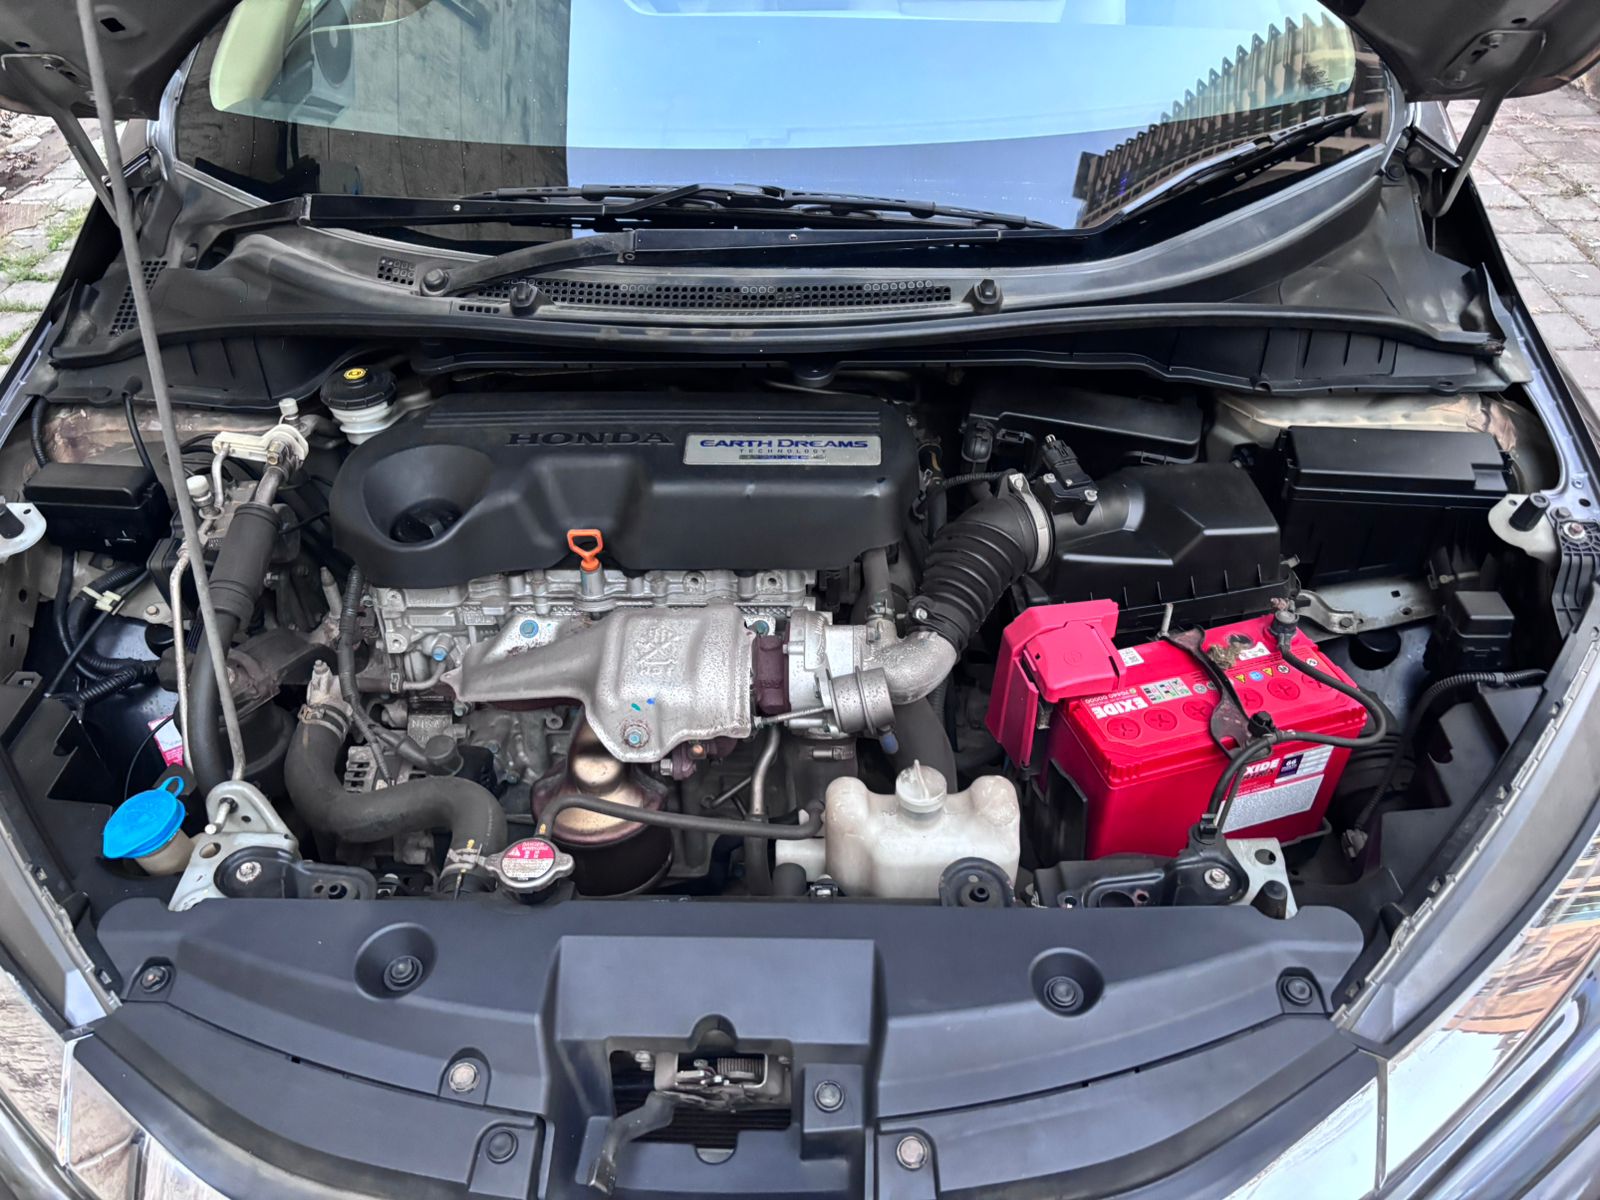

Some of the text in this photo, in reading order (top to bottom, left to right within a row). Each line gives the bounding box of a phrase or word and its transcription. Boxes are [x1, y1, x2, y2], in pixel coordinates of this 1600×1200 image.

[505, 431, 675, 447] HONDA
[700, 439, 868, 449] EARTH DREAMS
[1091, 697, 1148, 720] EXIDE
[1243, 758, 1280, 777] XIDE
